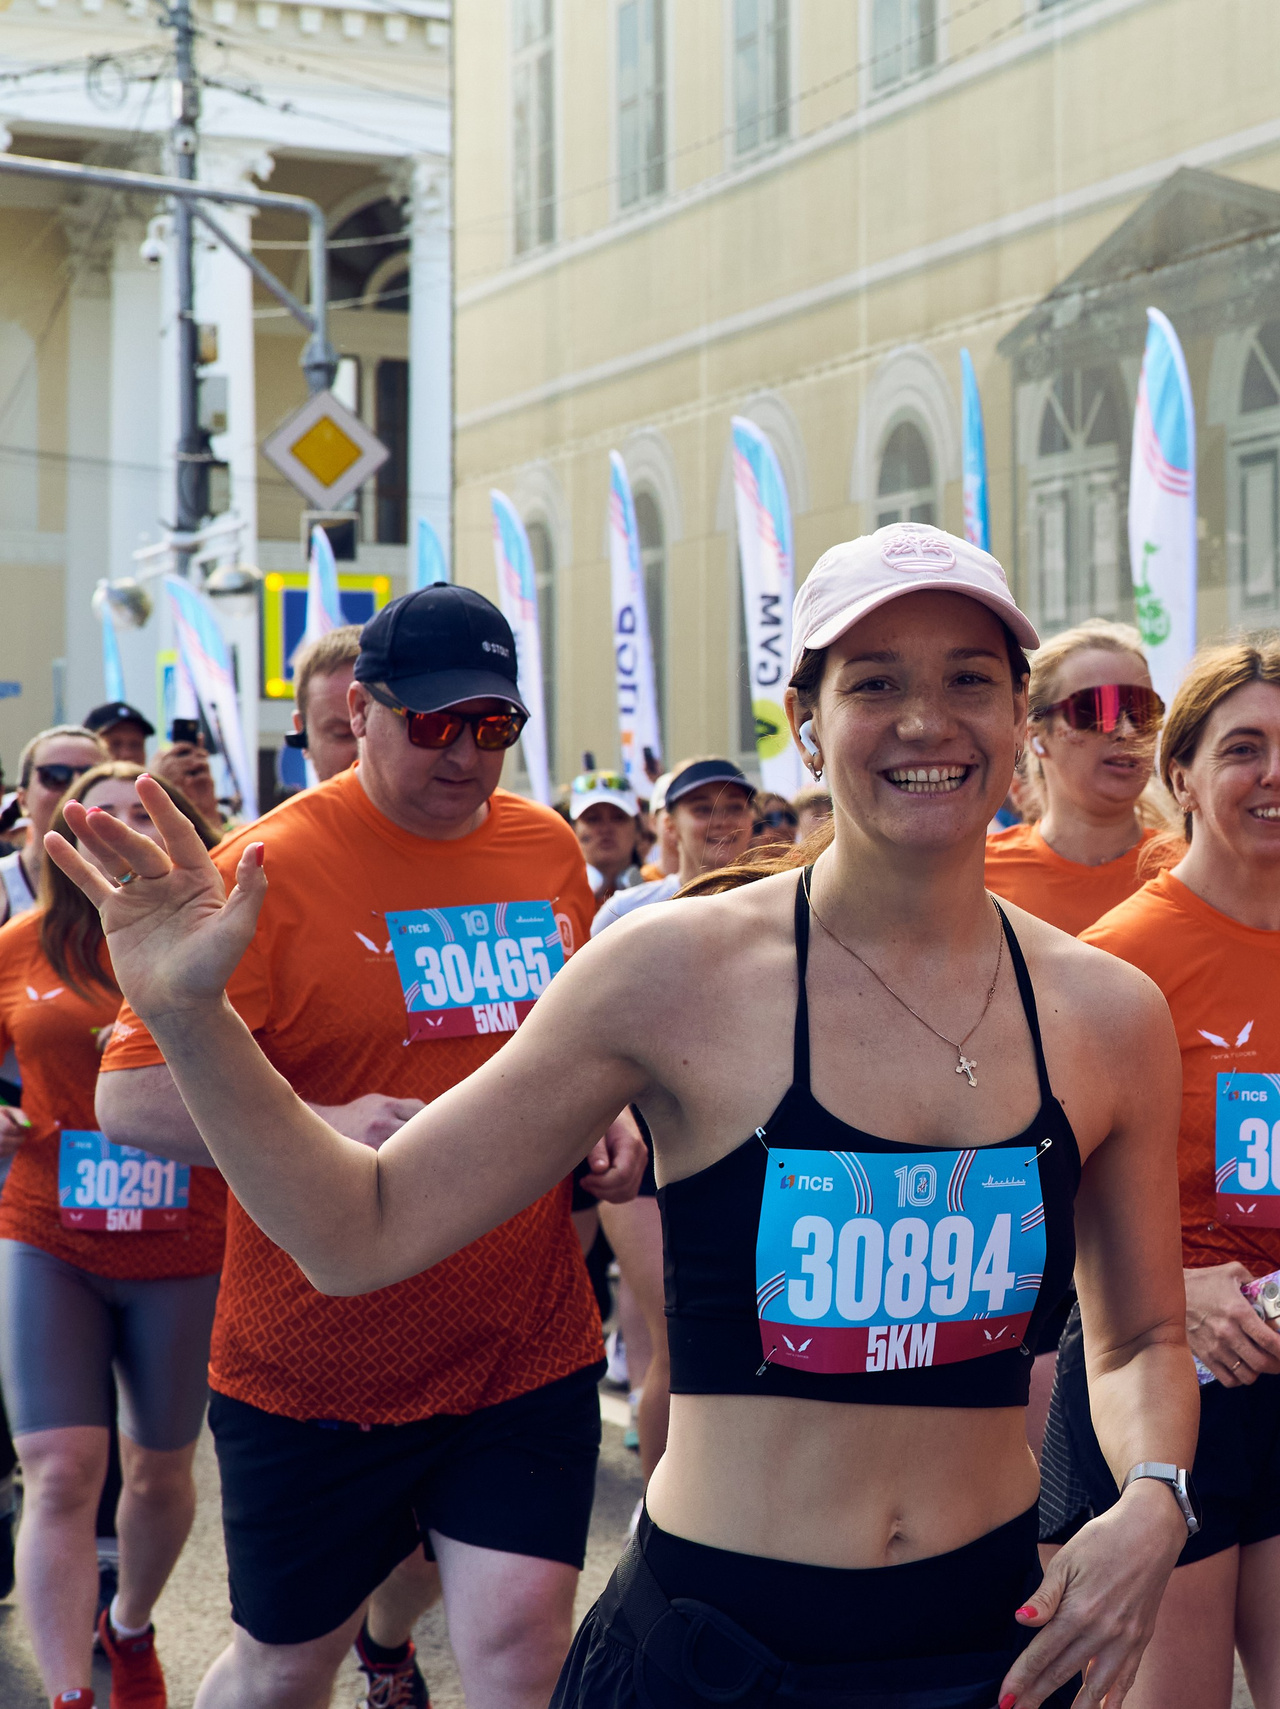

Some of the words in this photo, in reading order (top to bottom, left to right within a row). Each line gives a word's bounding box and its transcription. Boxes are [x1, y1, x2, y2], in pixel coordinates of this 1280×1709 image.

[415, 937, 552, 1007] 30465
[1241, 1090, 1268, 1102] ПСБ
[75, 1158, 176, 1207] 30291
[797, 1175, 834, 1192] ПСБ
[787, 1213, 1016, 1321] 30894
